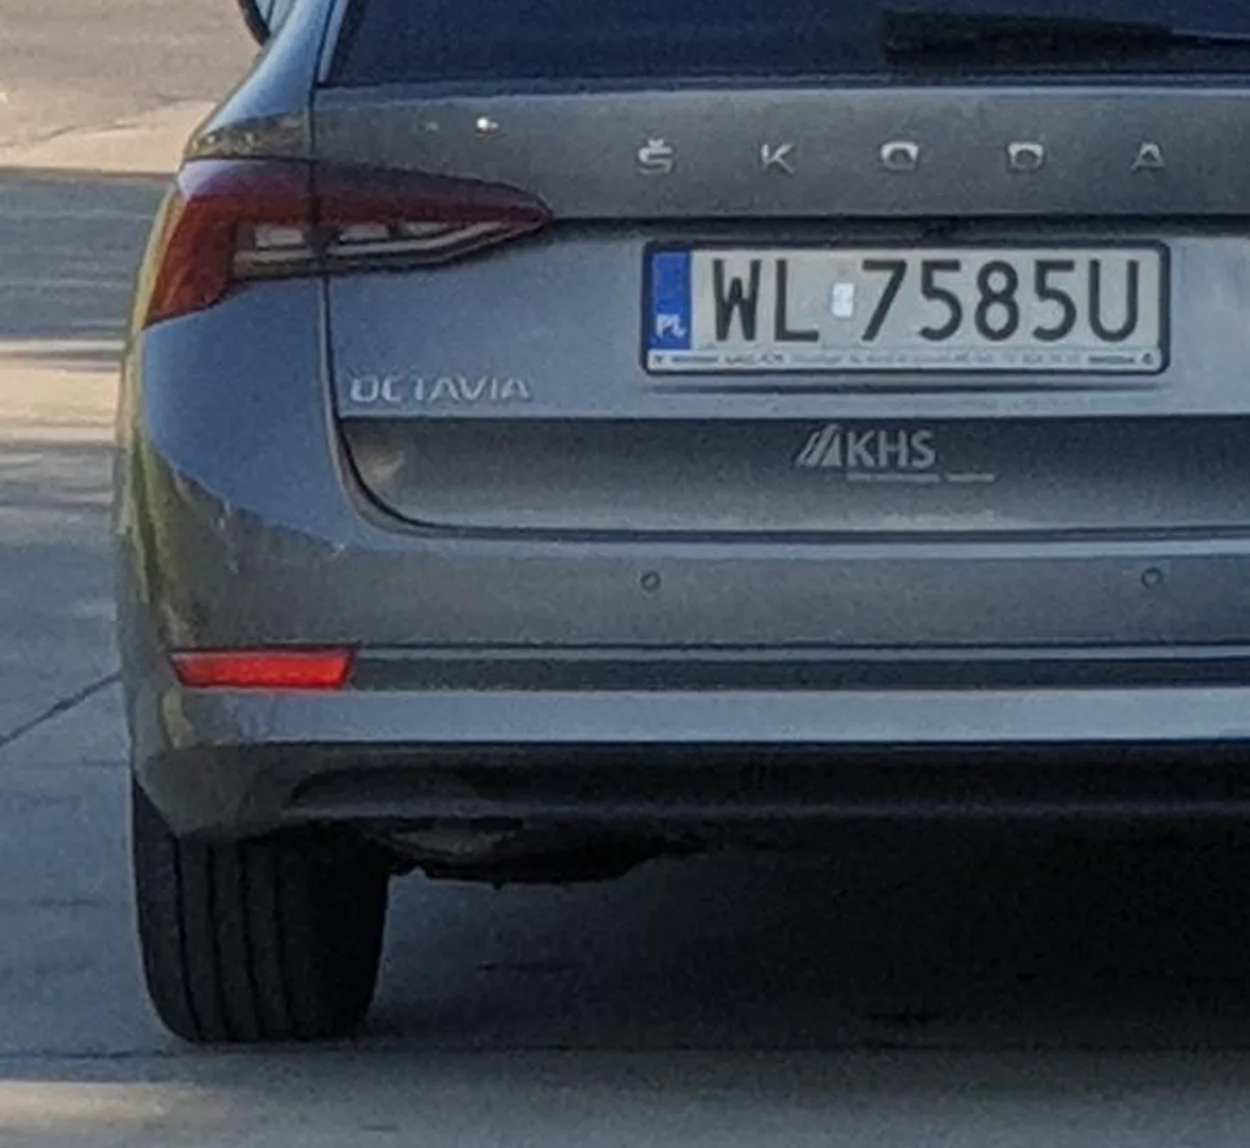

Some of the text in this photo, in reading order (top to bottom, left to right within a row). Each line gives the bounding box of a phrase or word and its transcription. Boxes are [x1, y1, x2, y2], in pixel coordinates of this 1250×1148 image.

[638, 138, 1165, 175] ŠKODA
[712, 258, 1139, 342] WL 7585U
[655, 314, 687, 339] PL
[351, 376, 531, 403] OCTAVIA
[847, 429, 936, 469] KHS
